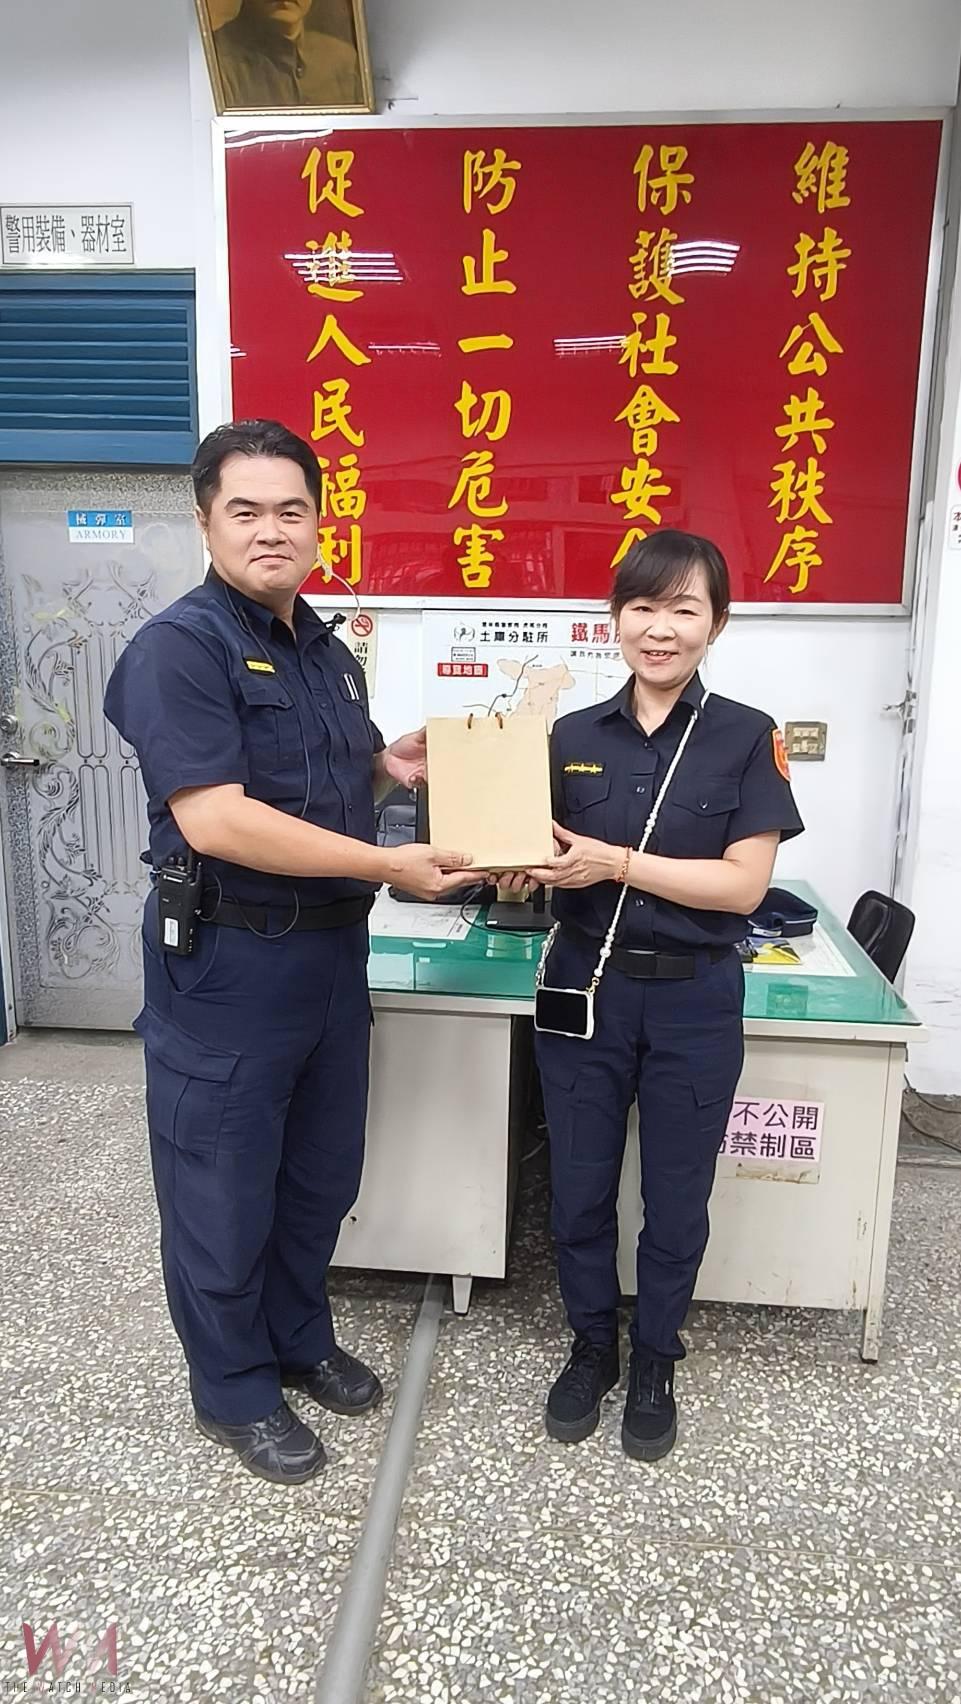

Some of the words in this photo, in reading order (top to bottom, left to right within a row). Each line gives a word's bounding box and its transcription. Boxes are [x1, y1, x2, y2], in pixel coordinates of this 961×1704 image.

[5, 214, 127, 254] 警用裝備、器材室
[302, 149, 368, 588] 促進人民福利
[448, 149, 521, 589] 防止一切危害
[763, 142, 852, 594] 維持公共秩序
[76, 529, 126, 540] ARMORY
[571, 622, 620, 644] 鐵馬
[732, 1101, 819, 1131] 不公開
